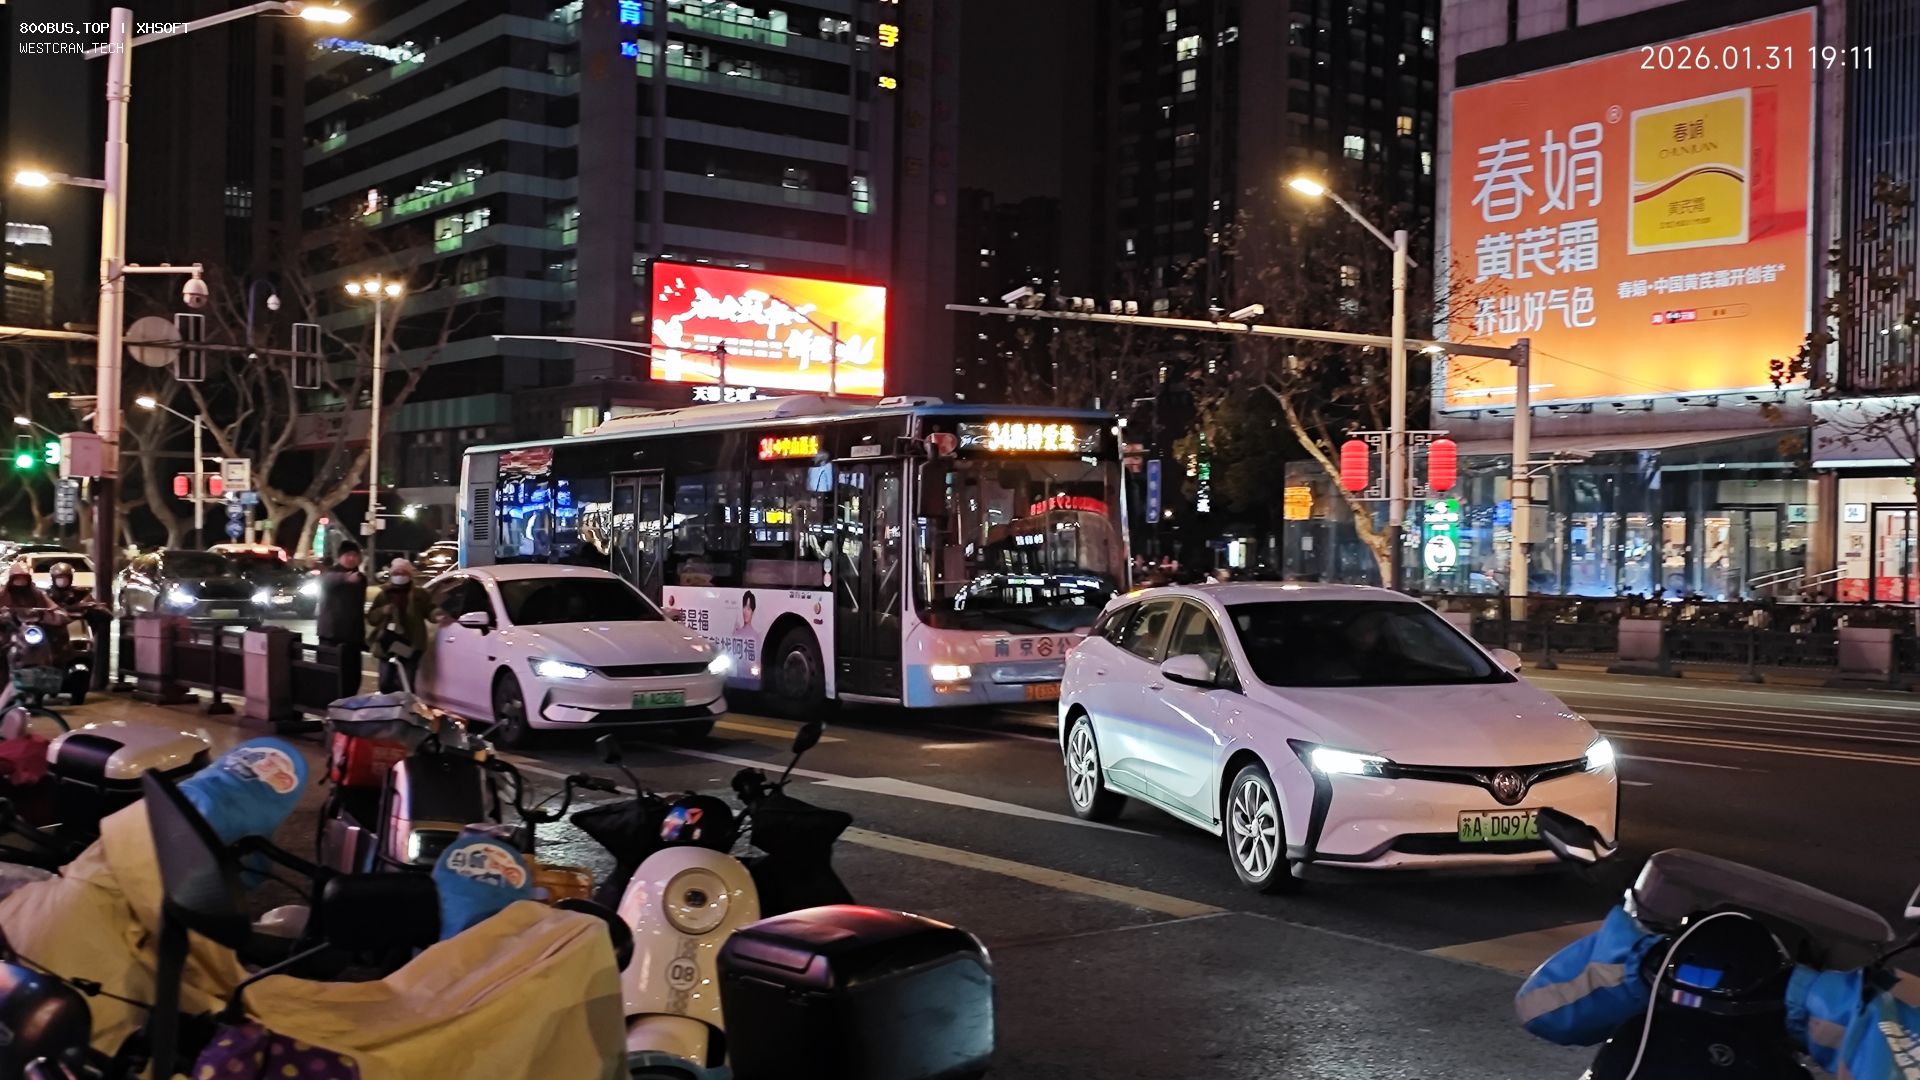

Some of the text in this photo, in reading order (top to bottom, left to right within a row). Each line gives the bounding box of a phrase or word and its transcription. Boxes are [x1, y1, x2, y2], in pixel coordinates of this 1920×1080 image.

[1471, 122, 1603, 223] 春娟
[1475, 218, 1599, 284] 黄芪霜
[1474, 286, 1597, 336] 养出好气色
[672, 964, 694, 981] 08
